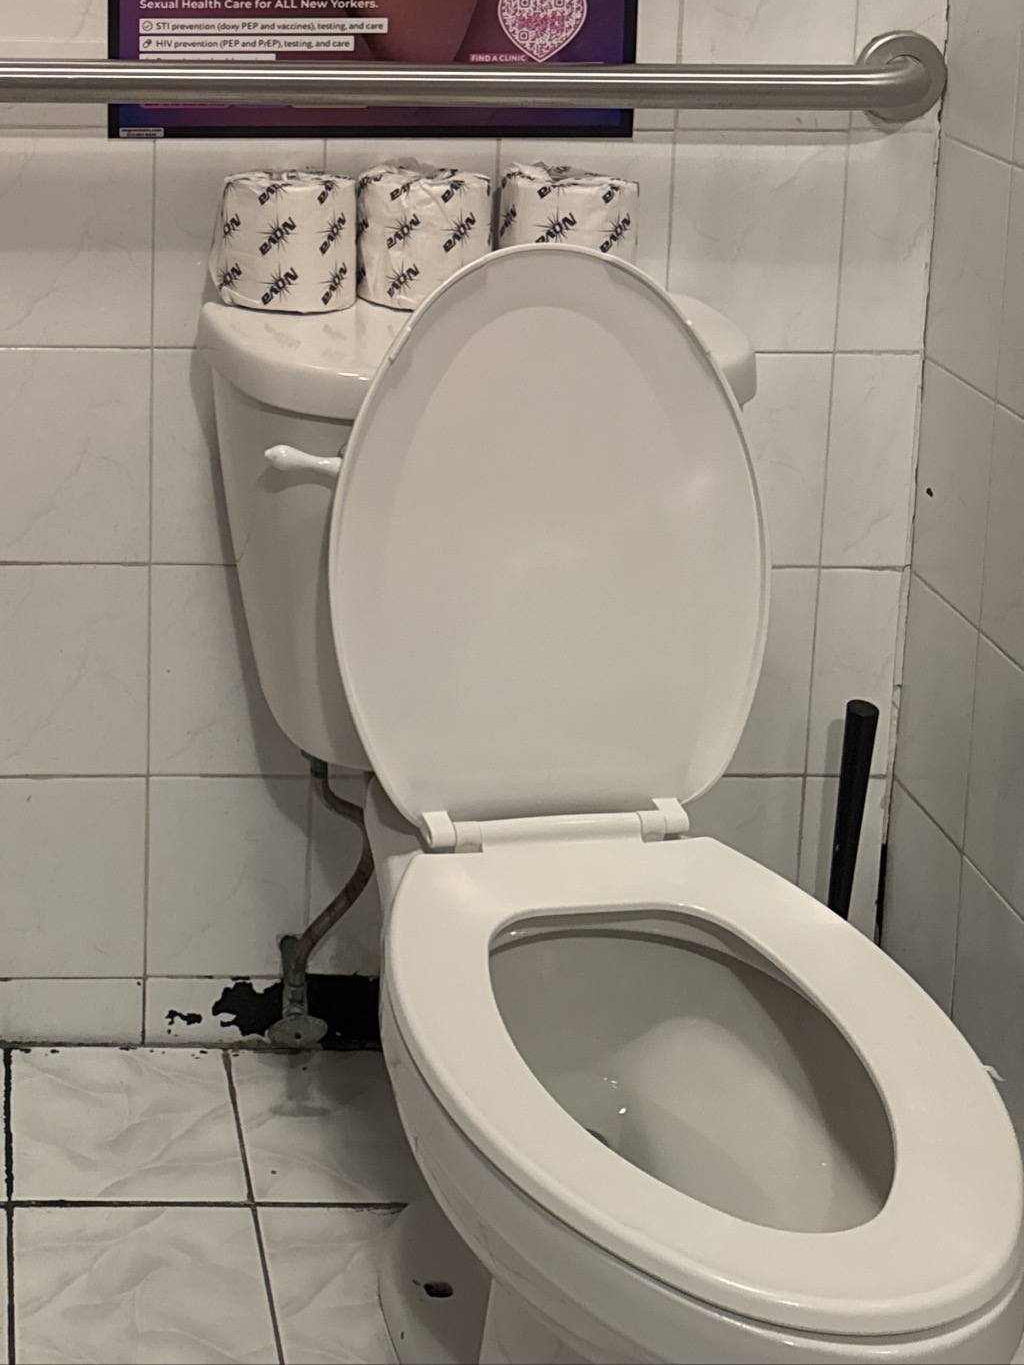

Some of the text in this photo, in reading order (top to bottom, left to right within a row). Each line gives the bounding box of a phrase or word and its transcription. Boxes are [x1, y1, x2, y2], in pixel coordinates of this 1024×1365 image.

[139, 0, 179, 9] Sexual
[181, 0, 222, 9] Health
[224, 0, 252, 9] Care
[274, 0, 298, 9] ALL
[300, 0, 328, 9] New
[156, 22, 170, 30] STI
[171, 22, 216, 32] prevention
[217, 22, 239, 32] (doxy
[241, 22, 258, 30] PEP
[260, 22, 276, 30] and
[348, 22, 364, 30] and
[156, 40, 172, 48] HIV
[174, 40, 218, 50] prevention
[219, 39, 240, 49] (PEP
[241, 40, 257, 48] and
[315, 40, 331, 48] and
[470, 54, 491, 62] FIND
[500, 54, 526, 62] CLINIC
[259, 216, 297, 256] Nova
[319, 212, 347, 256] Nova
[443, 212, 476, 253] Nova
[599, 212, 631, 253] Nova
[260, 267, 299, 306] Nova
[321, 262, 348, 306] Nova
